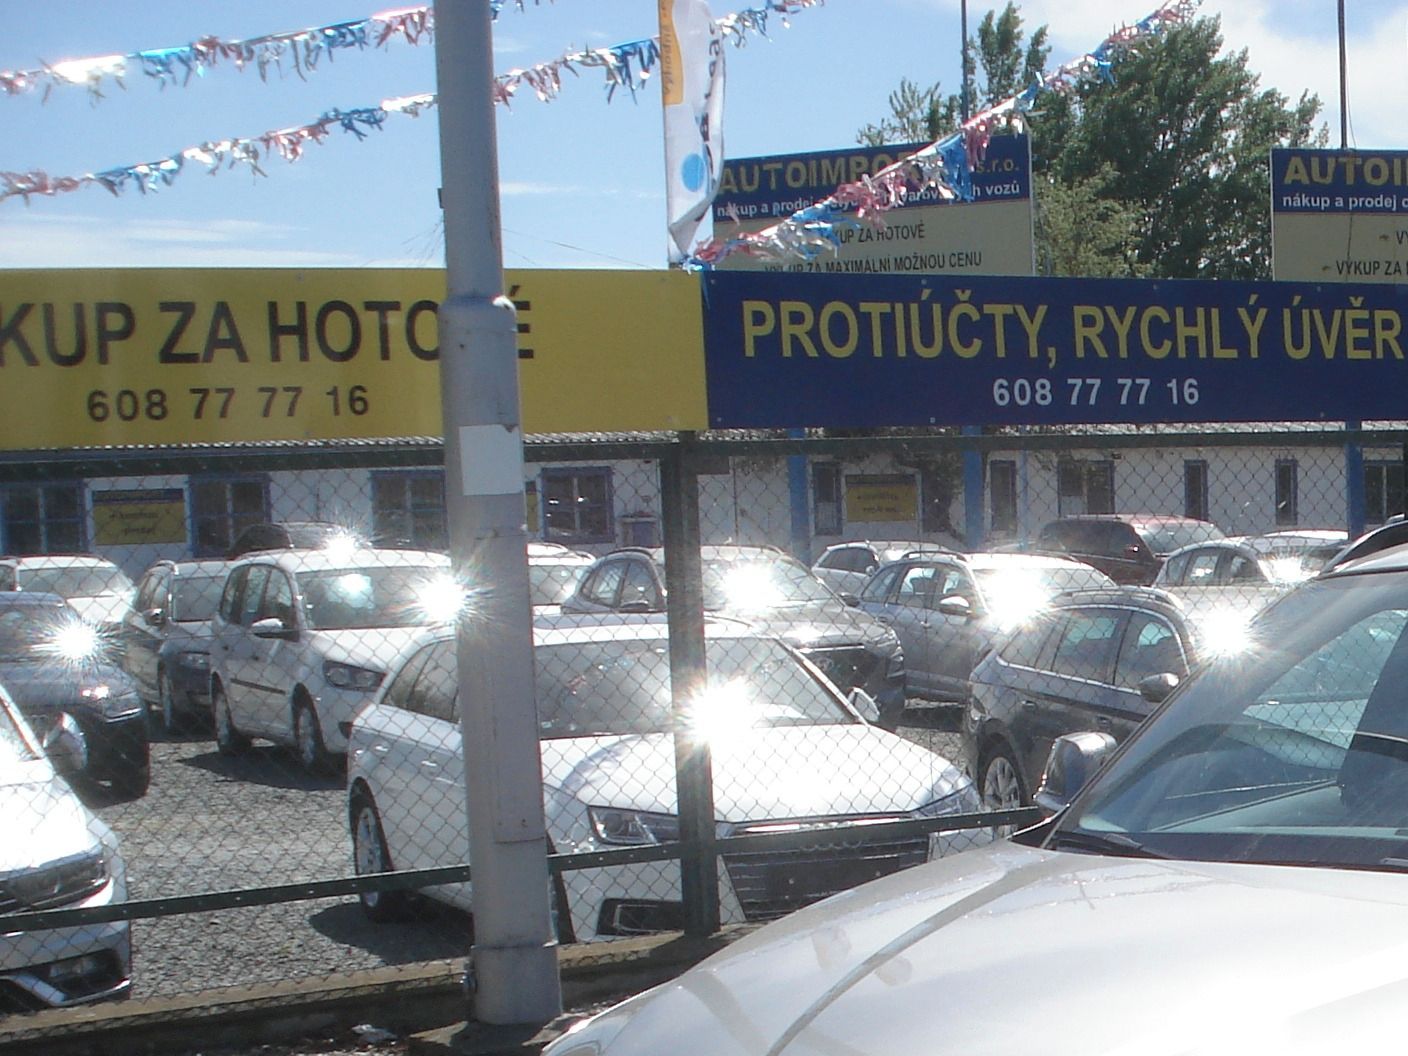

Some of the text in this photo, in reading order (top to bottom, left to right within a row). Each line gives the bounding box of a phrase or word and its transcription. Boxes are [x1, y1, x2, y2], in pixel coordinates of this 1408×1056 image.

[760, 205, 769, 214] a
[985, 180, 1020, 196] vozů
[1283, 193, 1330, 210] nákup
[1335, 197, 1344, 207] a
[1349, 193, 1397, 211] prodej
[858, 227, 873, 243] ZA
[893, 252, 946, 271] MOŽNOU
[949, 250, 982, 267] CENU
[1385, 261, 1402, 275] ZA
[159, 301, 249, 364] ZA
[742, 288, 1405, 368] PROTIÚČTY, RYCHLÝ ÚVĚR
[87, 385, 369, 422] 608 77 77 16
[992, 378, 1199, 406] 608 77 77 16
